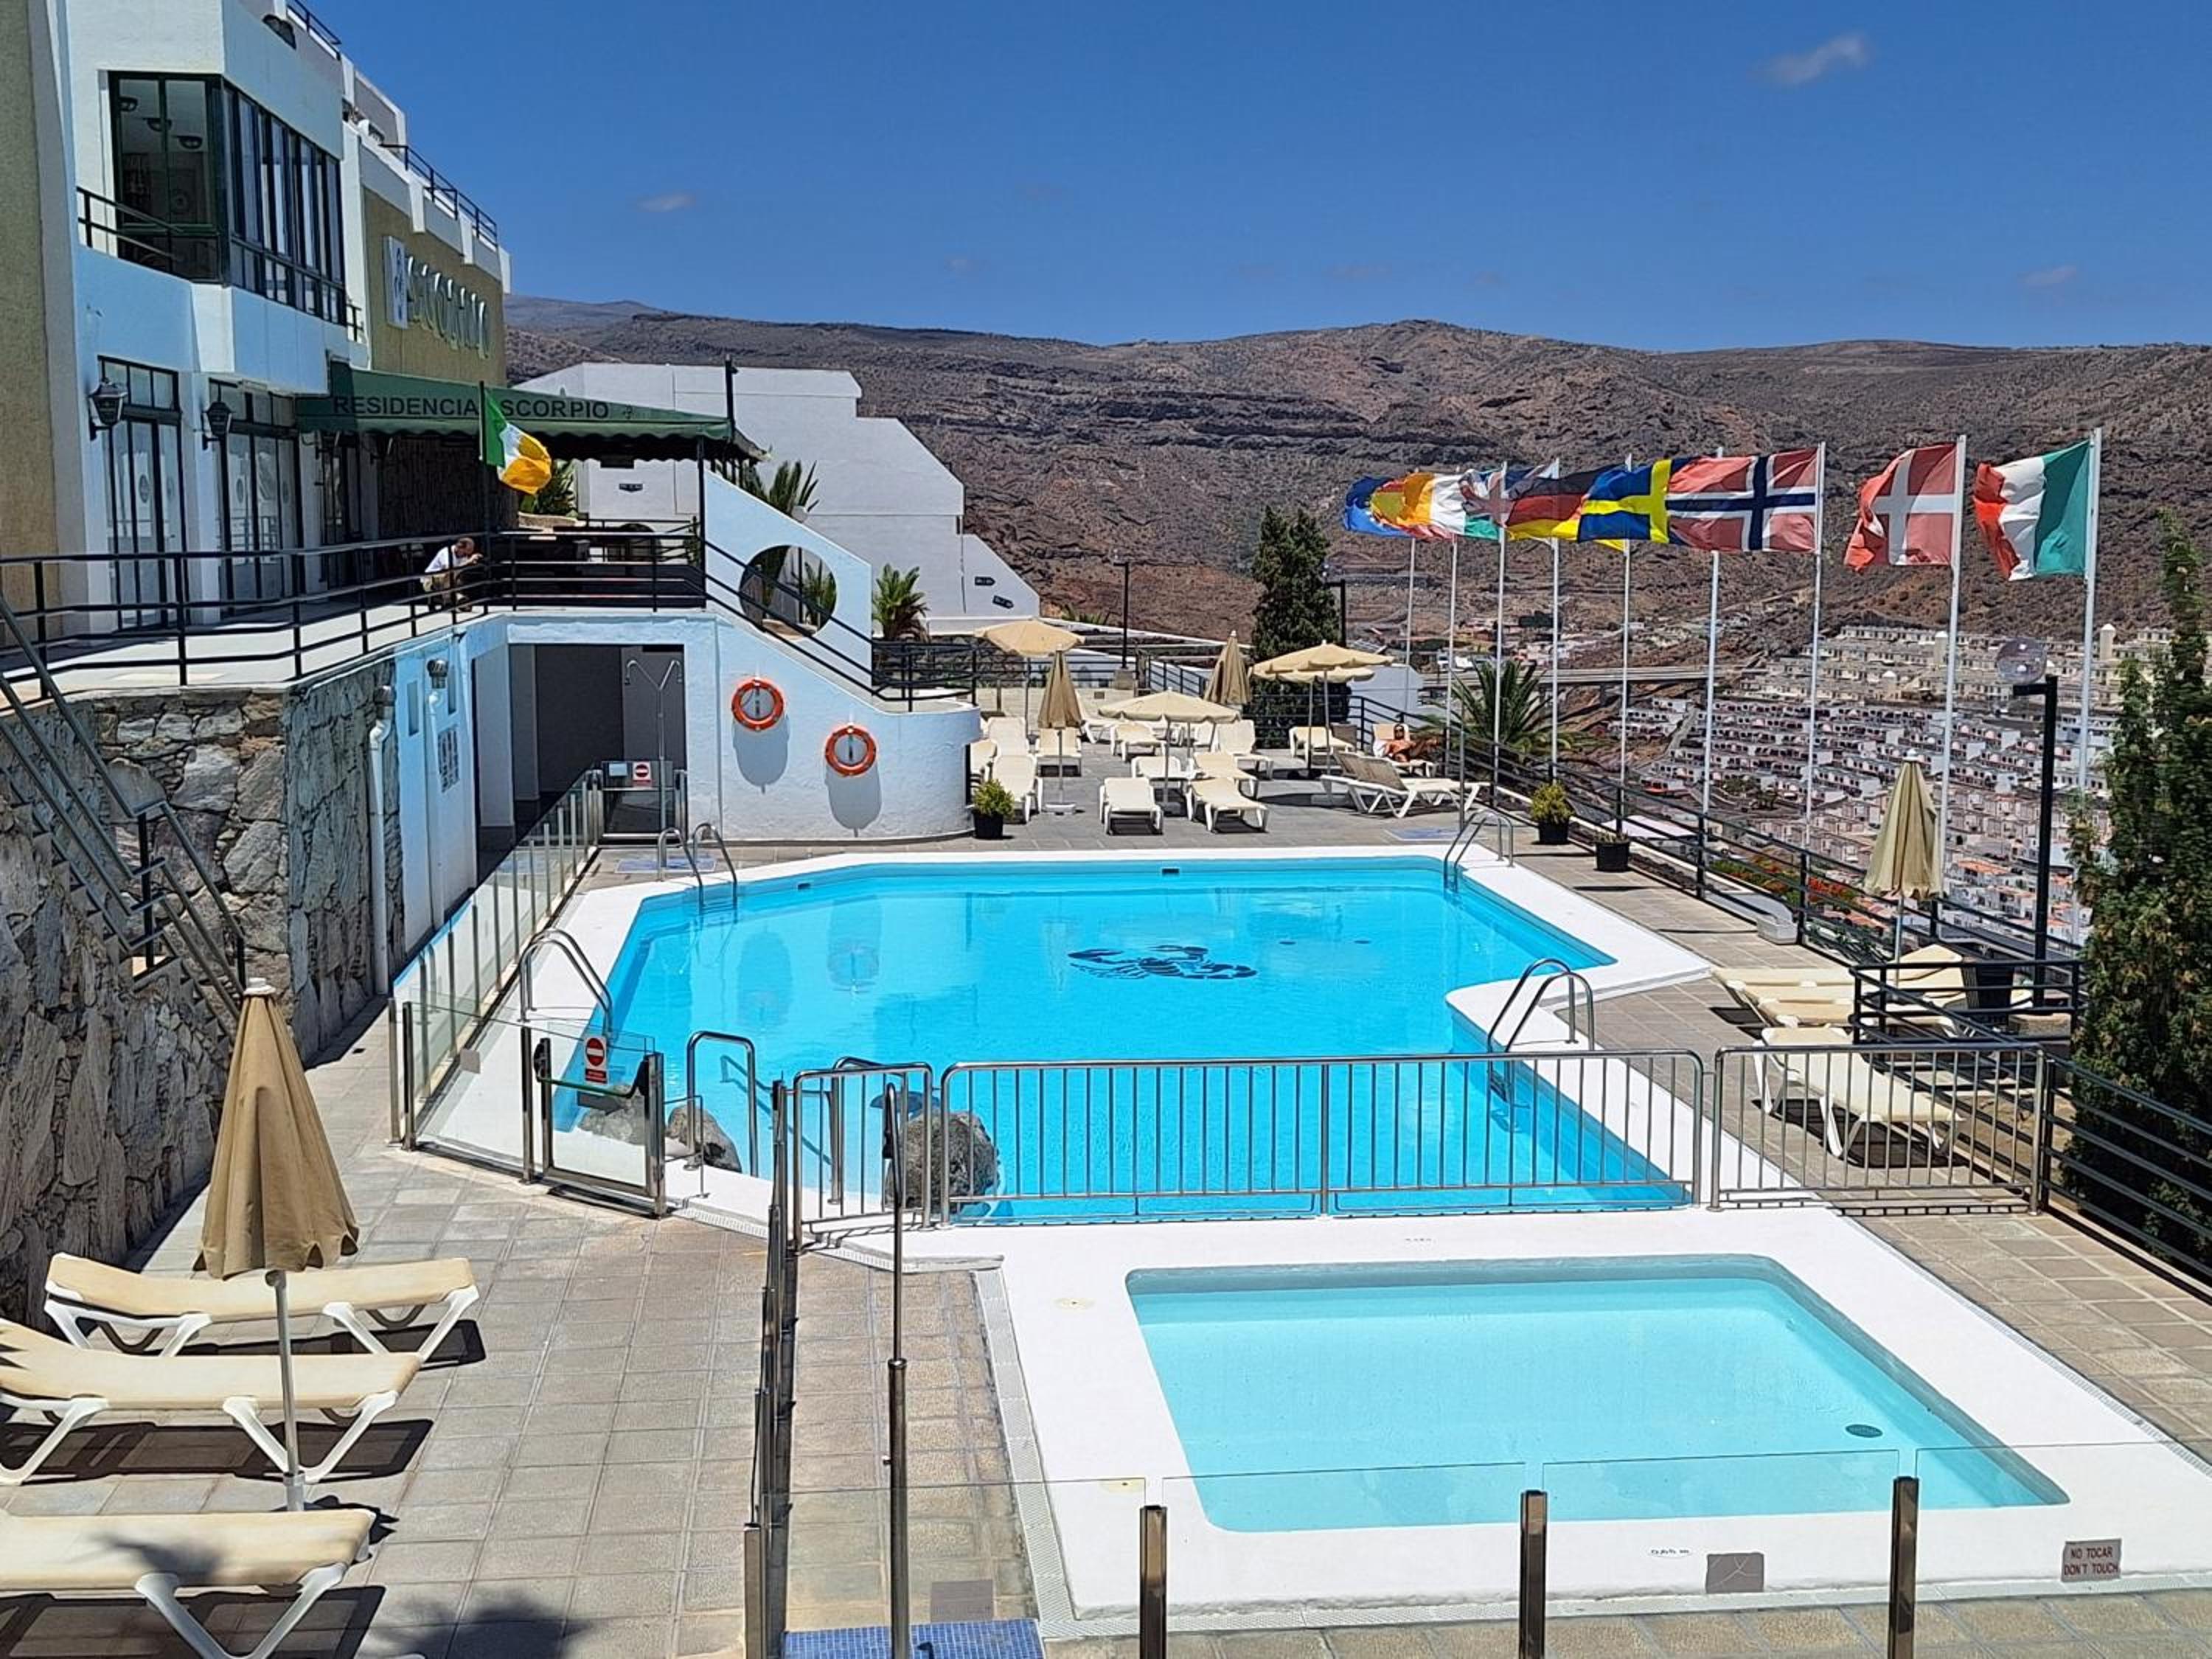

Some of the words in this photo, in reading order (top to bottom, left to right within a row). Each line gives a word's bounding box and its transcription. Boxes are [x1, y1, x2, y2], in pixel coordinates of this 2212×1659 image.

[333, 396, 480, 416] RESIDENCIA
[501, 399, 609, 419] SCORPIO
[2070, 1548, 2082, 1559] NO
[2087, 1546, 2113, 1559] TOCAR
[2092, 1562, 2118, 1574] TOUCH
